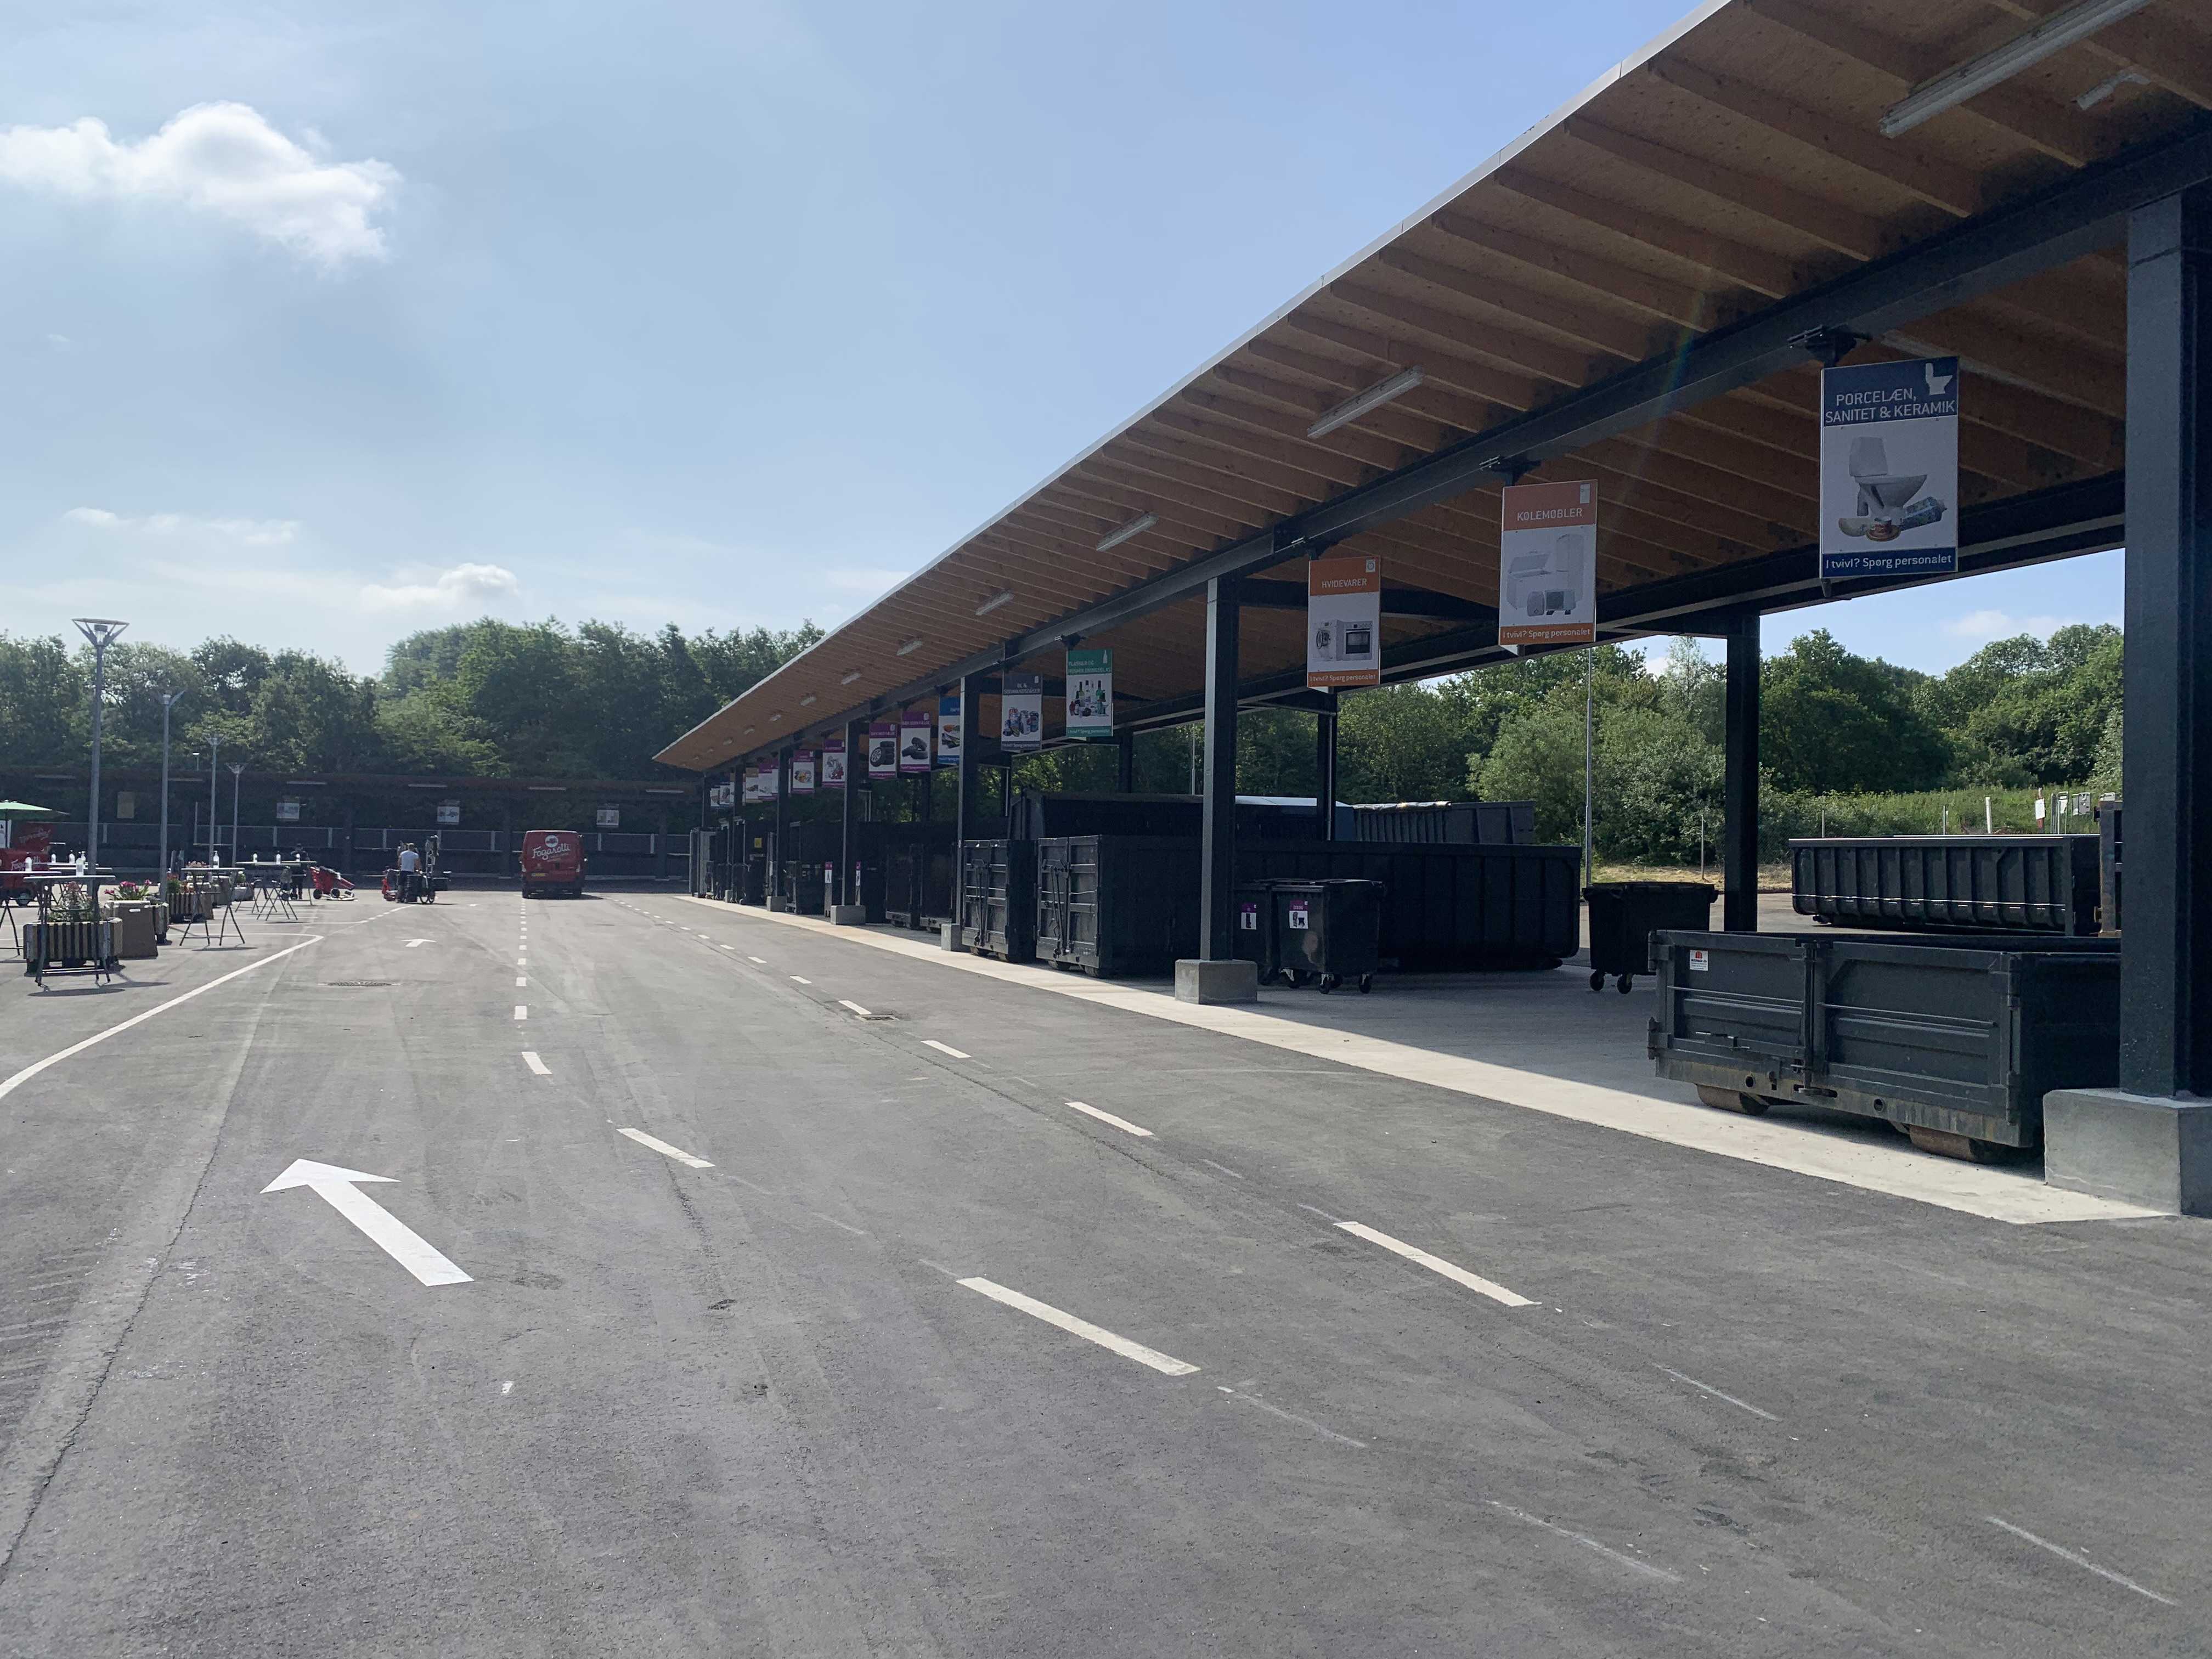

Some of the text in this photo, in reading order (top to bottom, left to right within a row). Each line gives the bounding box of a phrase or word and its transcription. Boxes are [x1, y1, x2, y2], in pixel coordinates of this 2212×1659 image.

[1836, 387, 1917, 407] PORCELÆN,
[1825, 400, 1955, 424] SANITET & KERAMIK
[1517, 508, 1583, 522] KØLEMØBLER
[1826, 554, 1952, 569] I tvivl? Spørg personalet
[1322, 578, 1368, 589] HVIDEVARER
[1551, 628, 1590, 639] personalet
